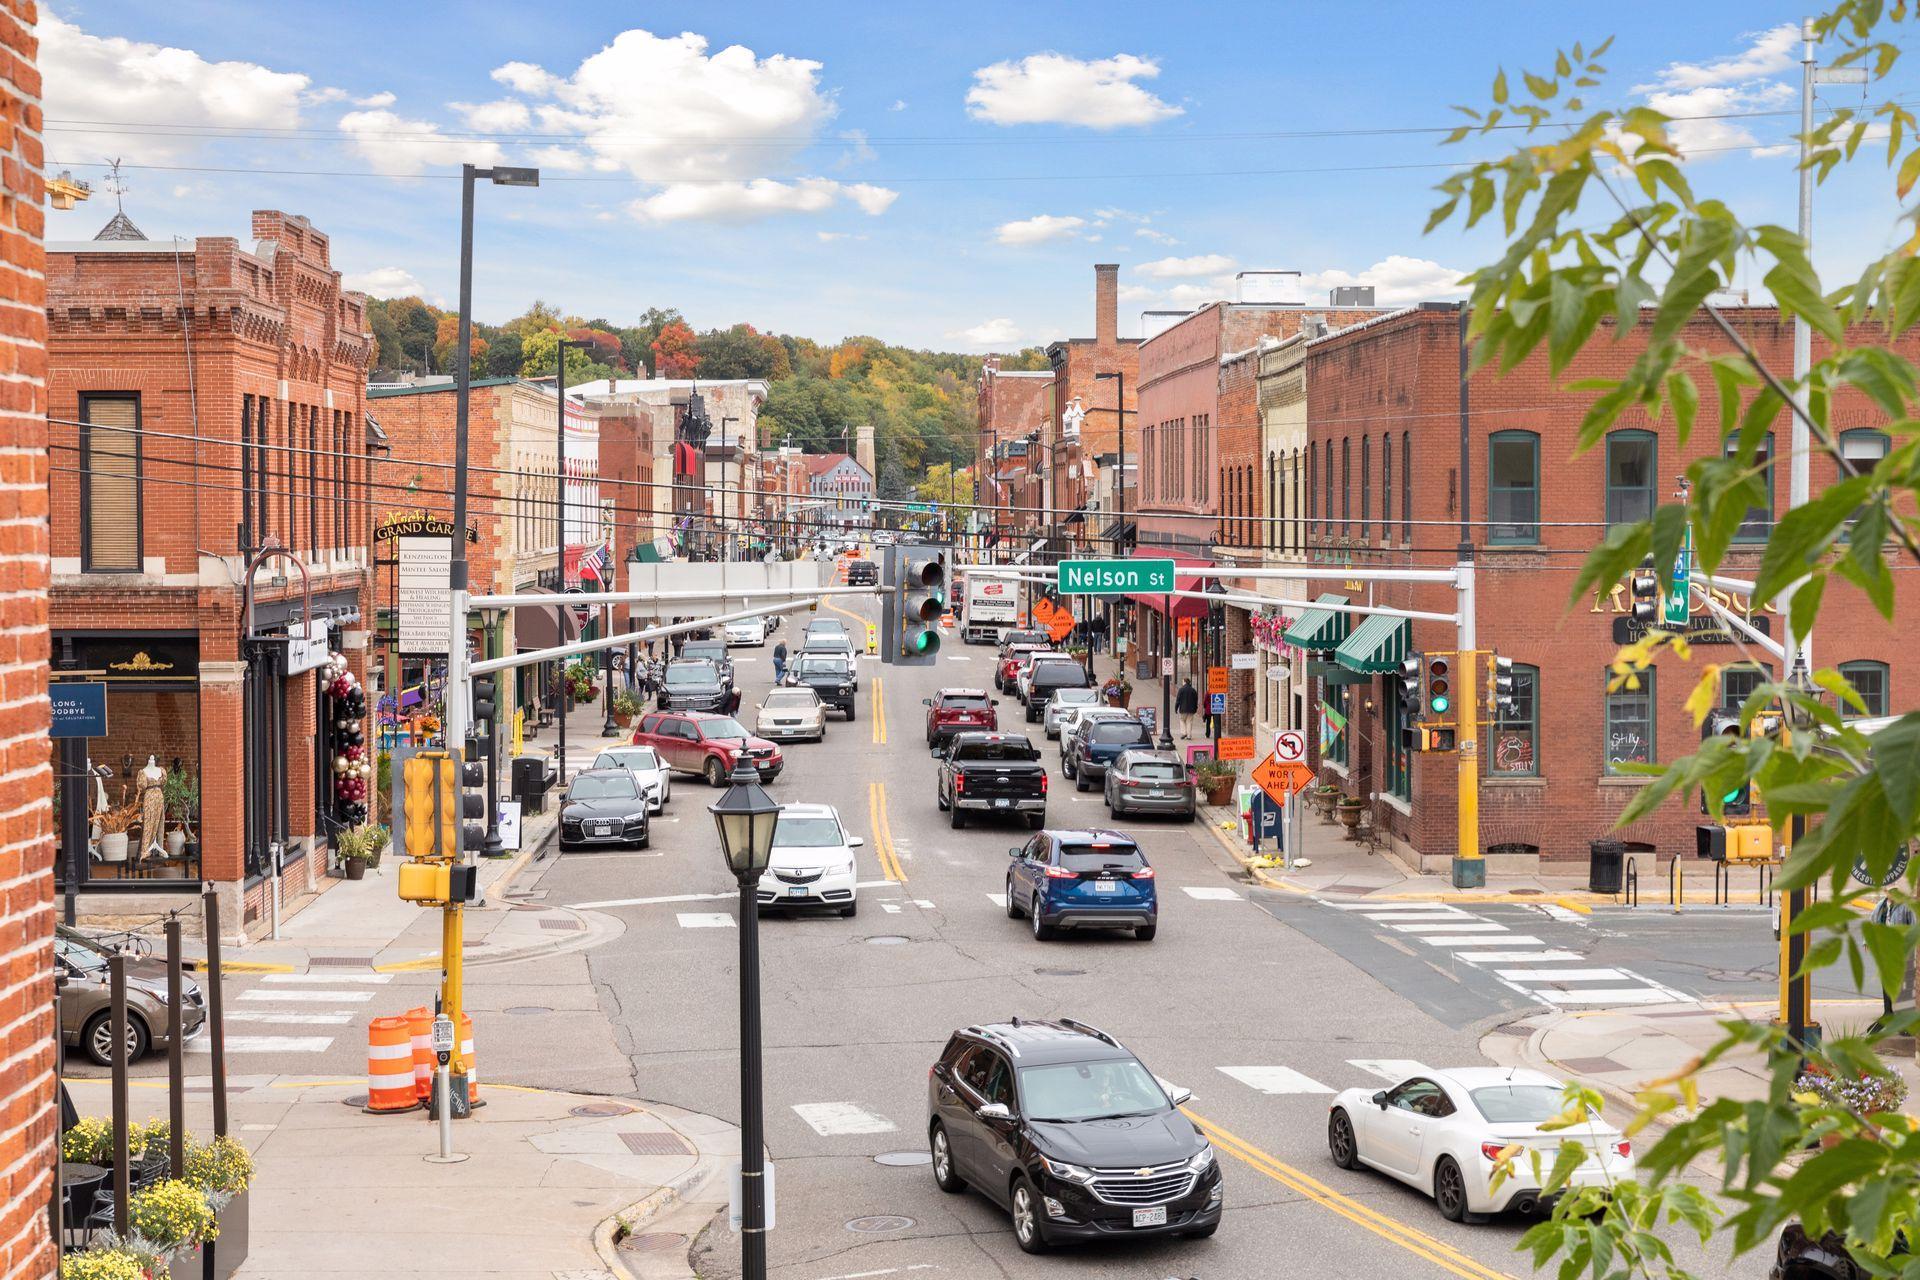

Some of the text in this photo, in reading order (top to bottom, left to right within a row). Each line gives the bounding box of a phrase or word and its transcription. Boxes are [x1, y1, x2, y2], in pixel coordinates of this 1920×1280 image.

[377, 522, 422, 540] GRAND
[425, 521, 474, 541] GARE
[1068, 567, 1165, 587] Nelson St
[1687, 617, 1721, 630] LIVIN
[1611, 732, 1640, 755] Stilly
[1268, 770, 1296, 779] WORK
